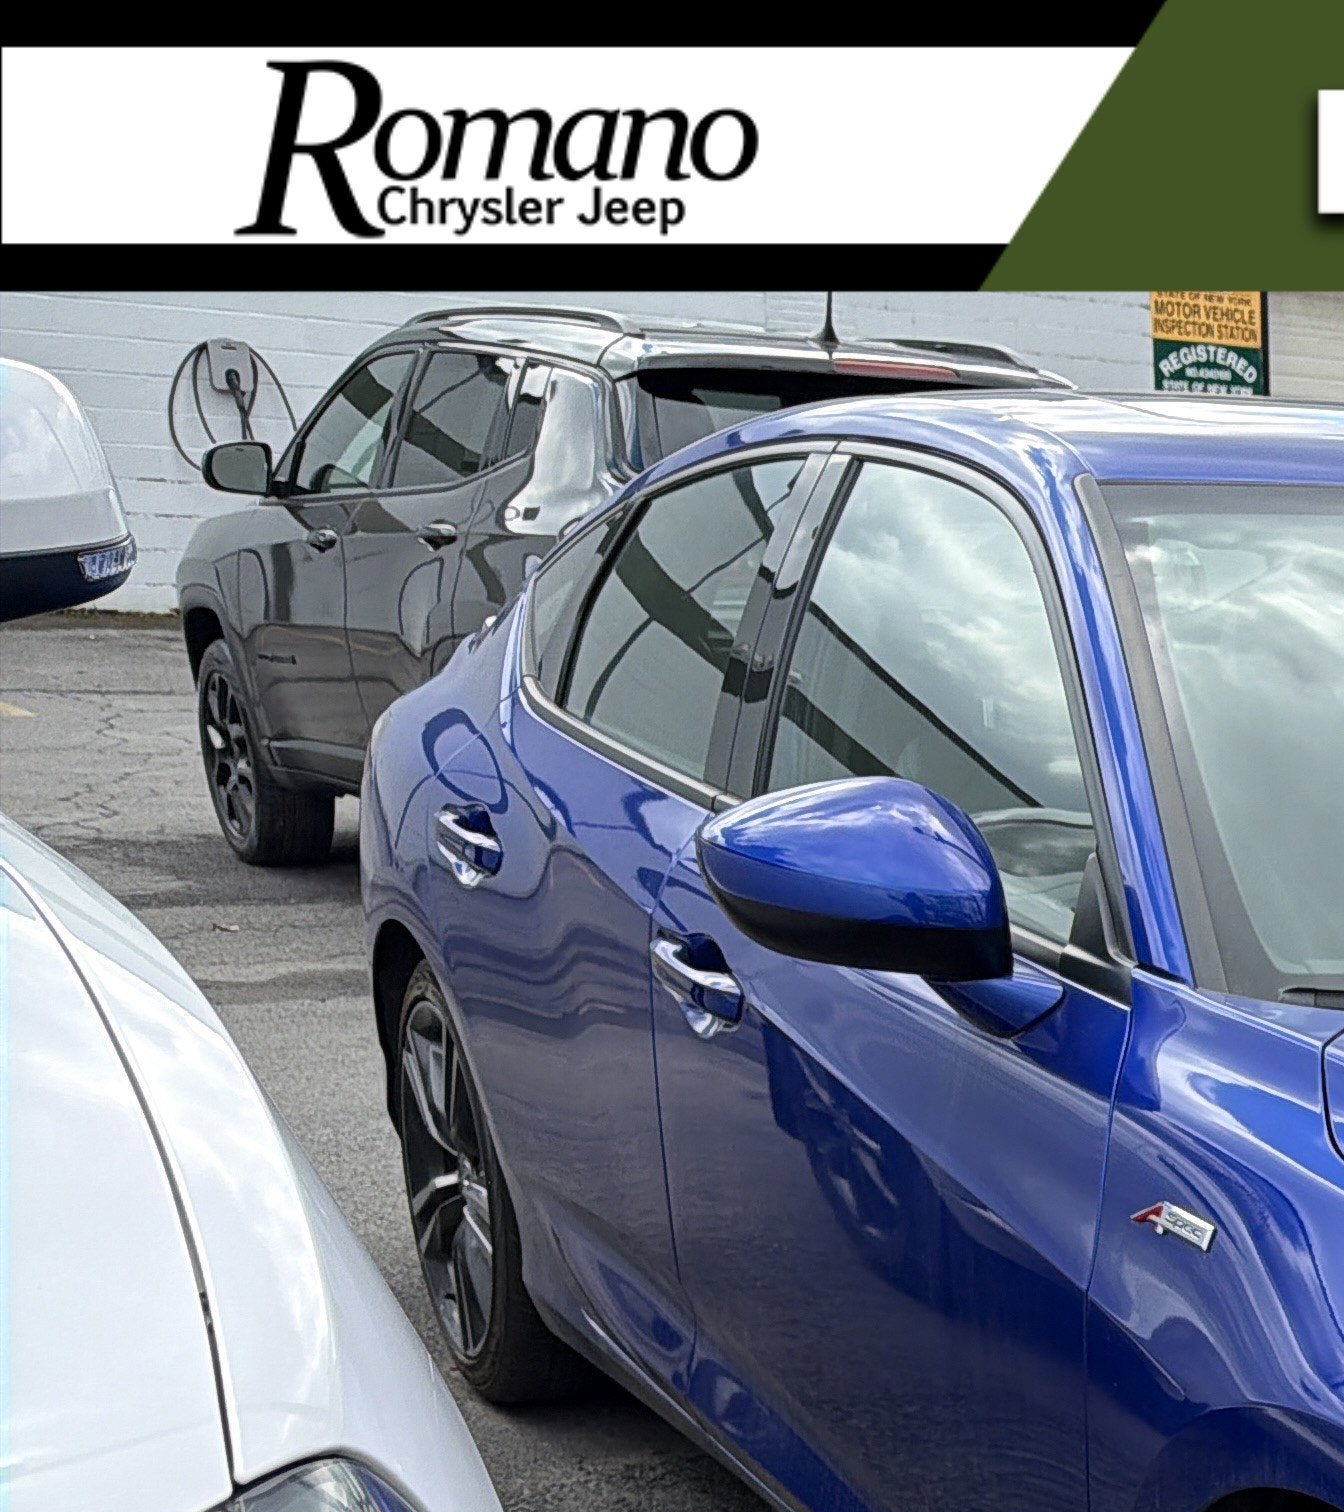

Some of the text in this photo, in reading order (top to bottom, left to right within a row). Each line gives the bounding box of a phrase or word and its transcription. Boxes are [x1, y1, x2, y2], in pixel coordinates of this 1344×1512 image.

[1154, 299, 1256, 326] MOTOR VEHICLE
[1153, 317, 1258, 342] INSPECTION STATION
[1158, 344, 1257, 383] REGISTERED
